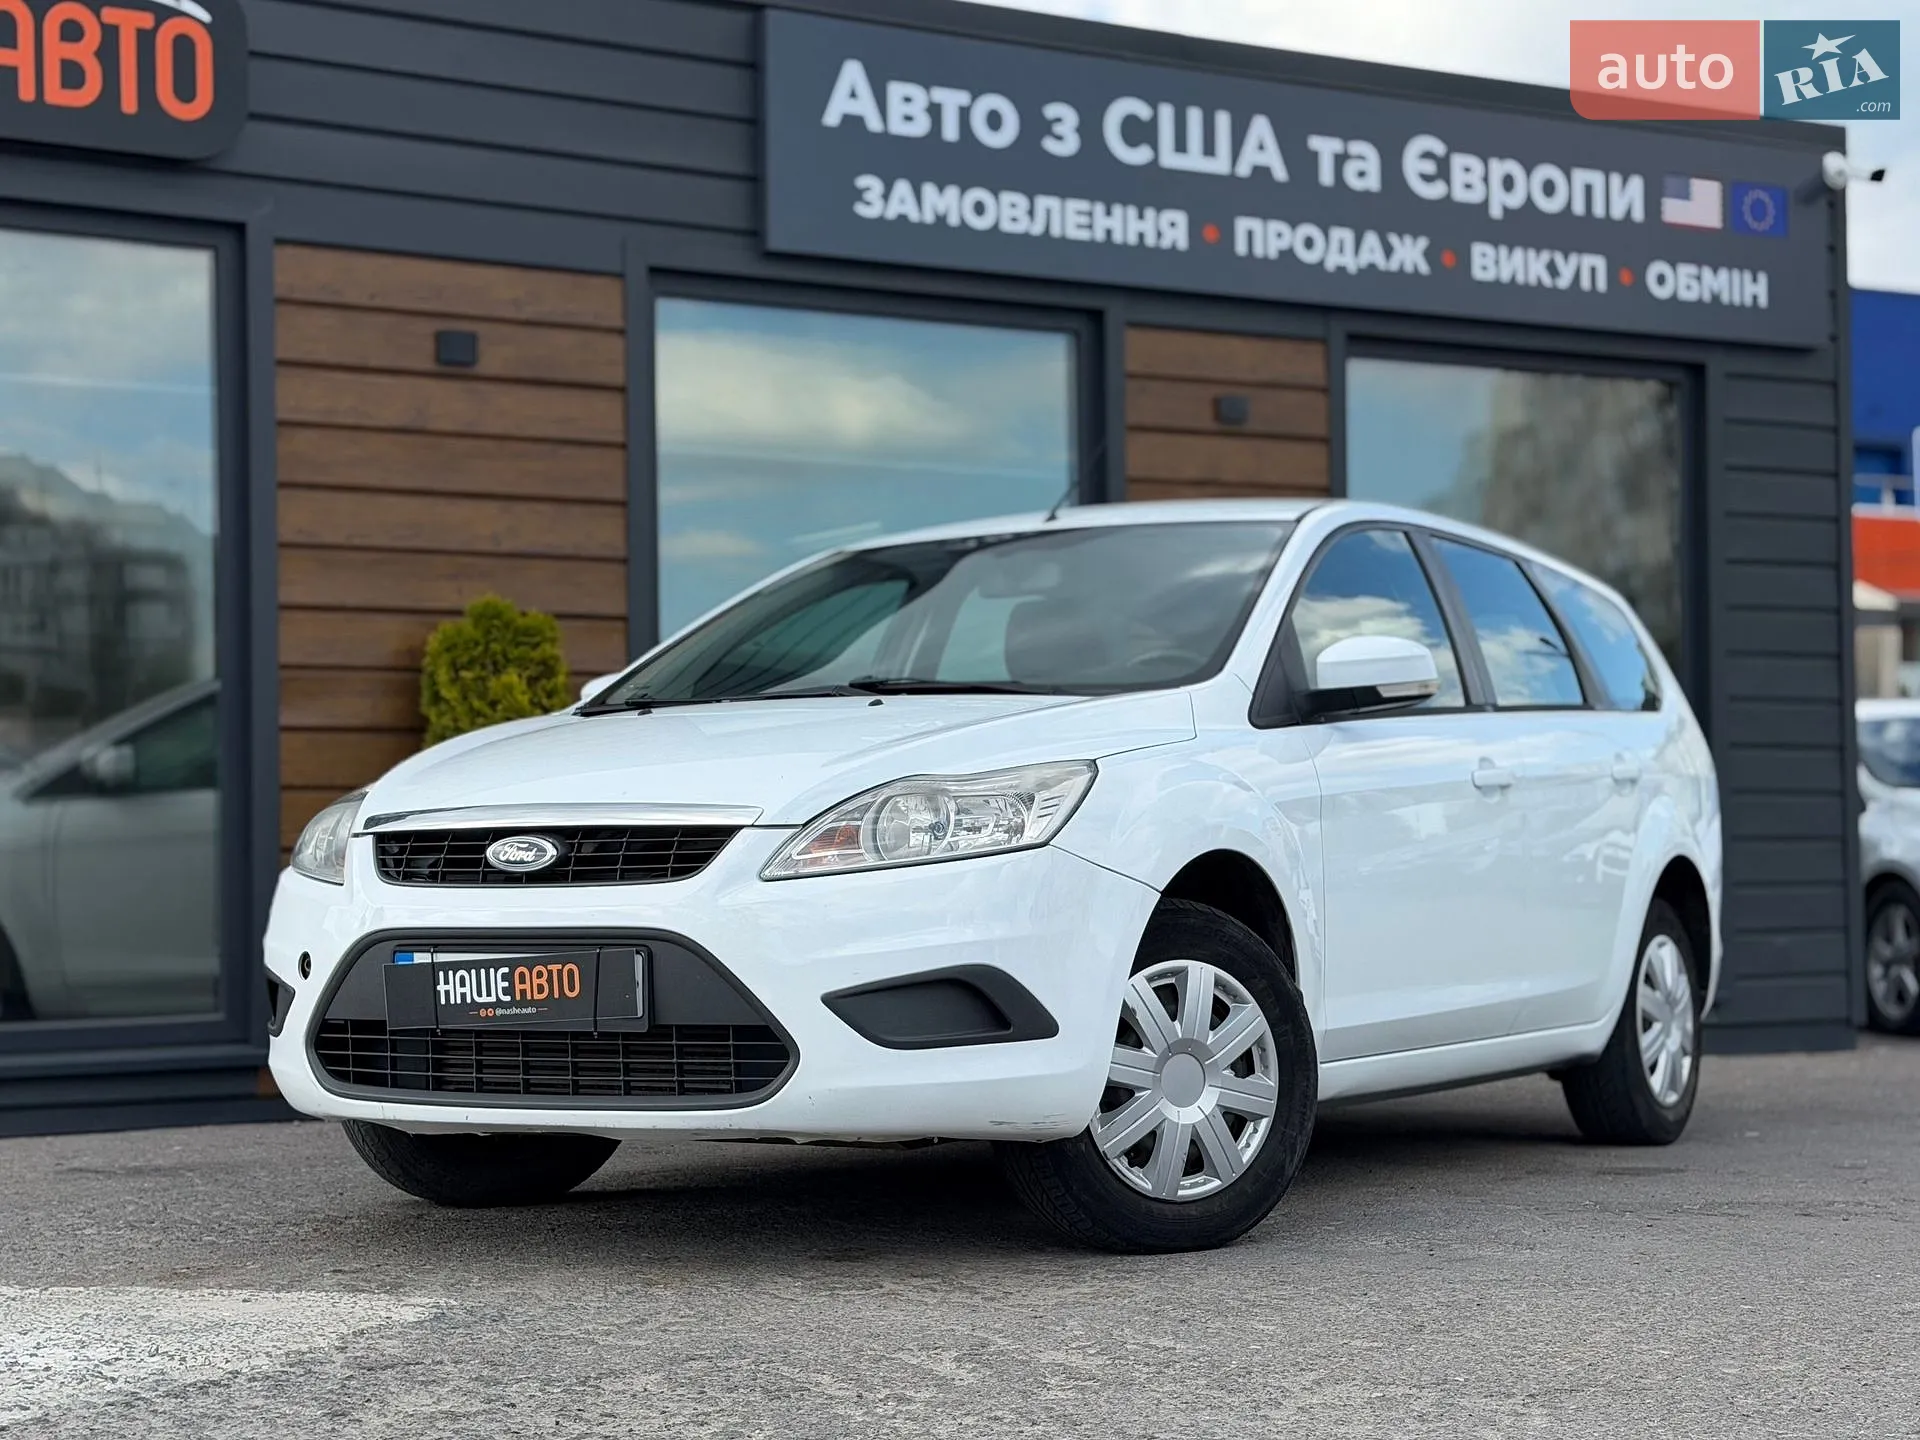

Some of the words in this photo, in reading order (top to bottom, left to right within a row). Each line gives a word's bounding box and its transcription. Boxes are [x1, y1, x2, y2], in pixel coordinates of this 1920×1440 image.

[0, 1, 215, 122] АВТО
[1102, 96, 1290, 184] США
[1307, 134, 1382, 193] та
[1402, 133, 1646, 223] Європи
[853, 173, 1189, 252] ЗАМОВЛЕННЯ
[1233, 215, 1431, 276] ПРОДАЖ
[1470, 241, 1608, 293] ВИКУП
[1645, 259, 1769, 310] ОБМІН
[498, 843, 538, 863] Ford
[436, 966, 512, 1005] НАШЕ
[513, 962, 581, 1001] АВТО
